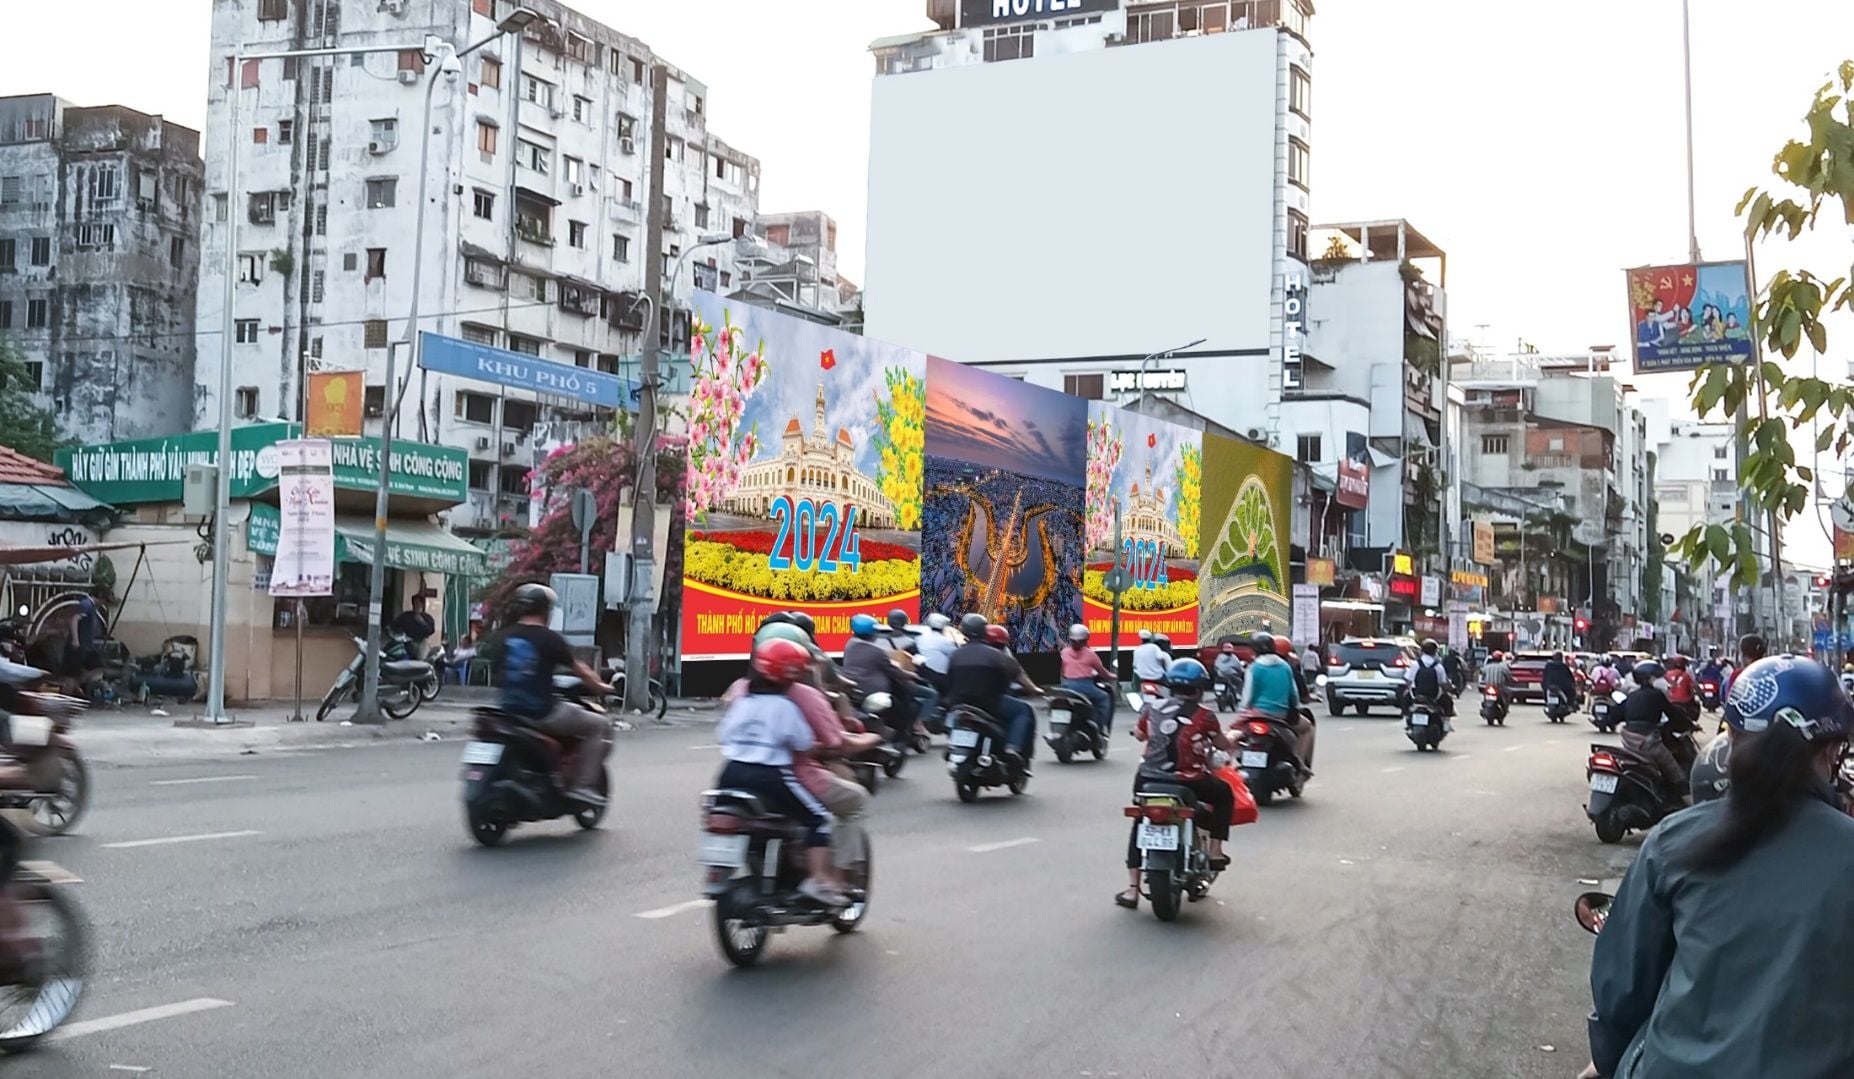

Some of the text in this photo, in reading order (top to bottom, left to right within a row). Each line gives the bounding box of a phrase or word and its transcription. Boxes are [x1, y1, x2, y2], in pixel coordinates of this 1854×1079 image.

[1284, 274, 1302, 386] HOTEL
[477, 357, 528, 380] KHU
[535, 370, 581, 391] PHỐ
[586, 383, 597, 394] 5
[121, 446, 148, 480] THÀNH
[150, 440, 167, 480] PHỐ
[333, 442, 463, 484] NHÀ VỆ SNH CÔNG CỘNG
[249, 538, 277, 552] CÔN
[769, 496, 861, 573] 2024
[404, 549, 429, 567] SINH
[431, 551, 457, 571] CÔNG
[697, 609, 724, 634] THÀNH
[726, 608, 743, 634] PHỐ
